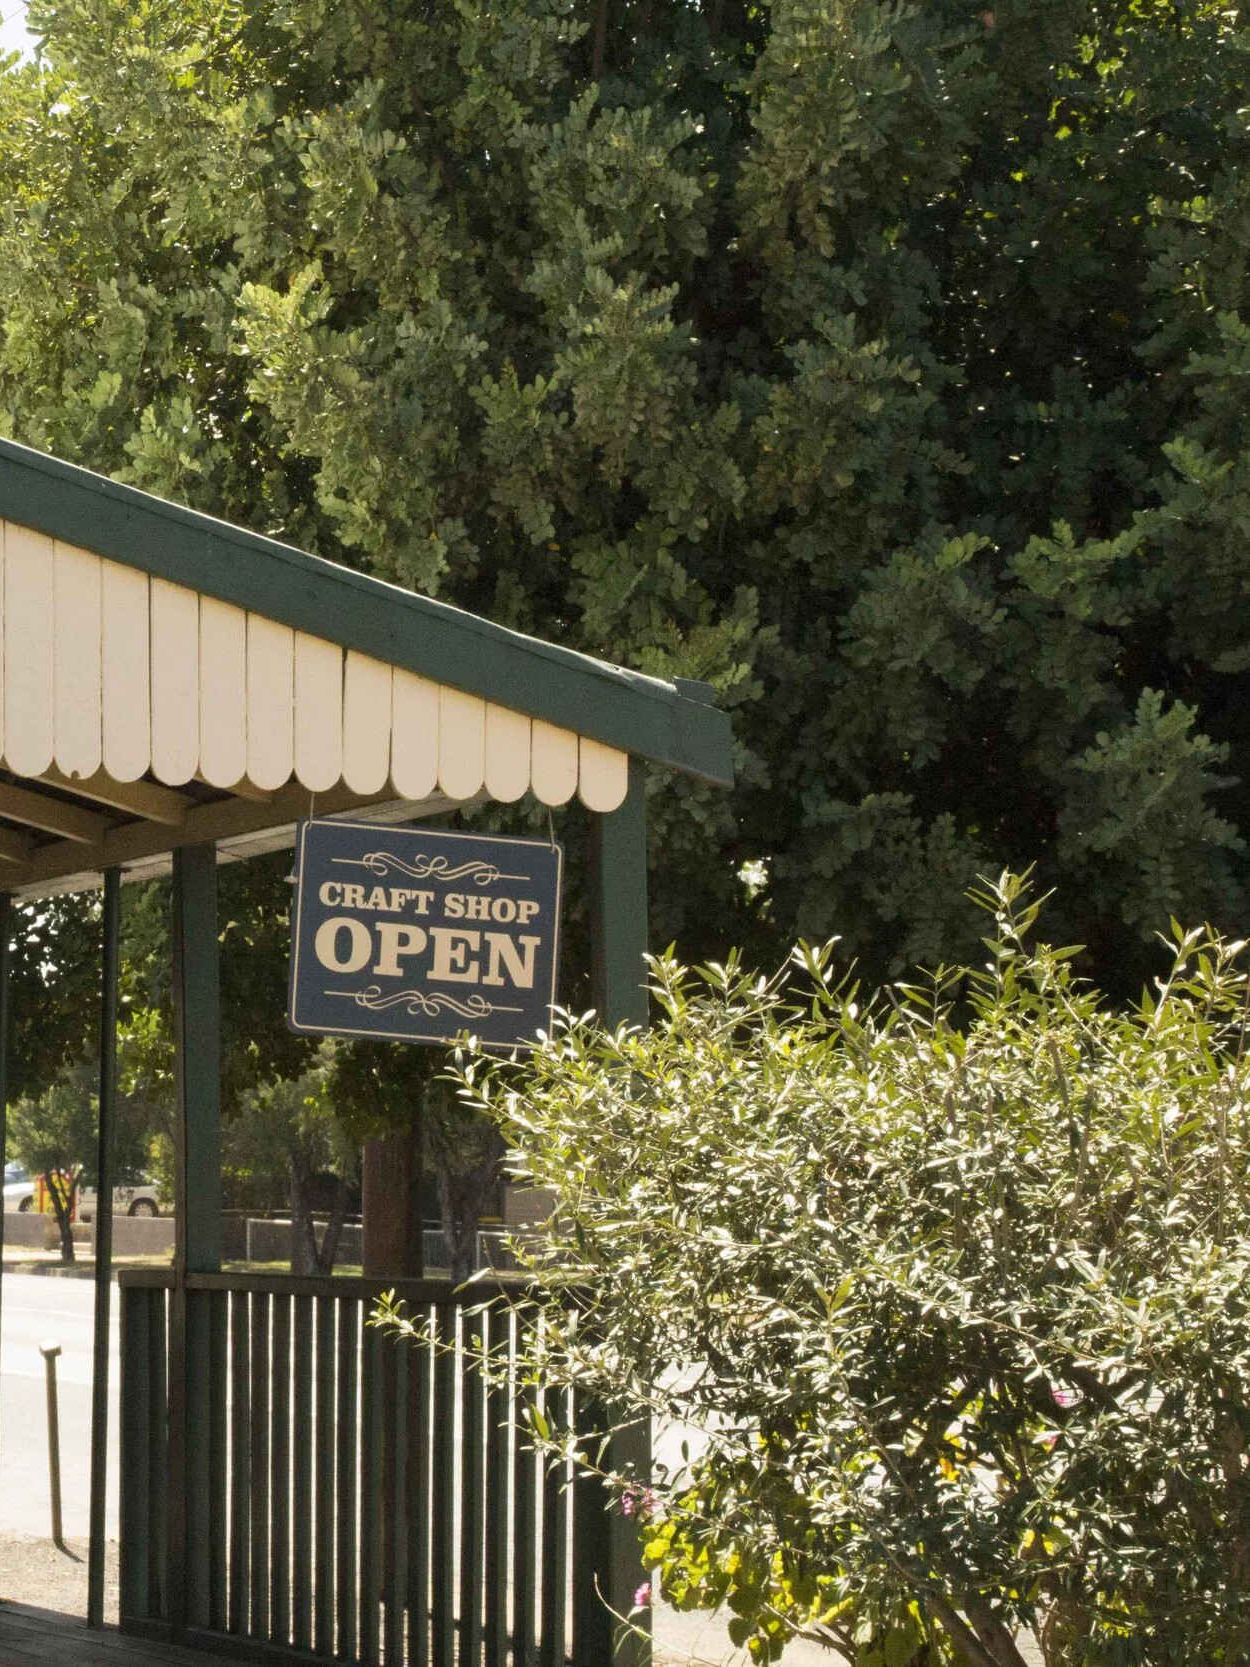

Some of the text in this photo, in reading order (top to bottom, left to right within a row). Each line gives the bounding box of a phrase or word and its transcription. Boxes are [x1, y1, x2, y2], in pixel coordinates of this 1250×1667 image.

[319, 881, 540, 924] CRAFT SHOP
[315, 917, 541, 989] OPEN
